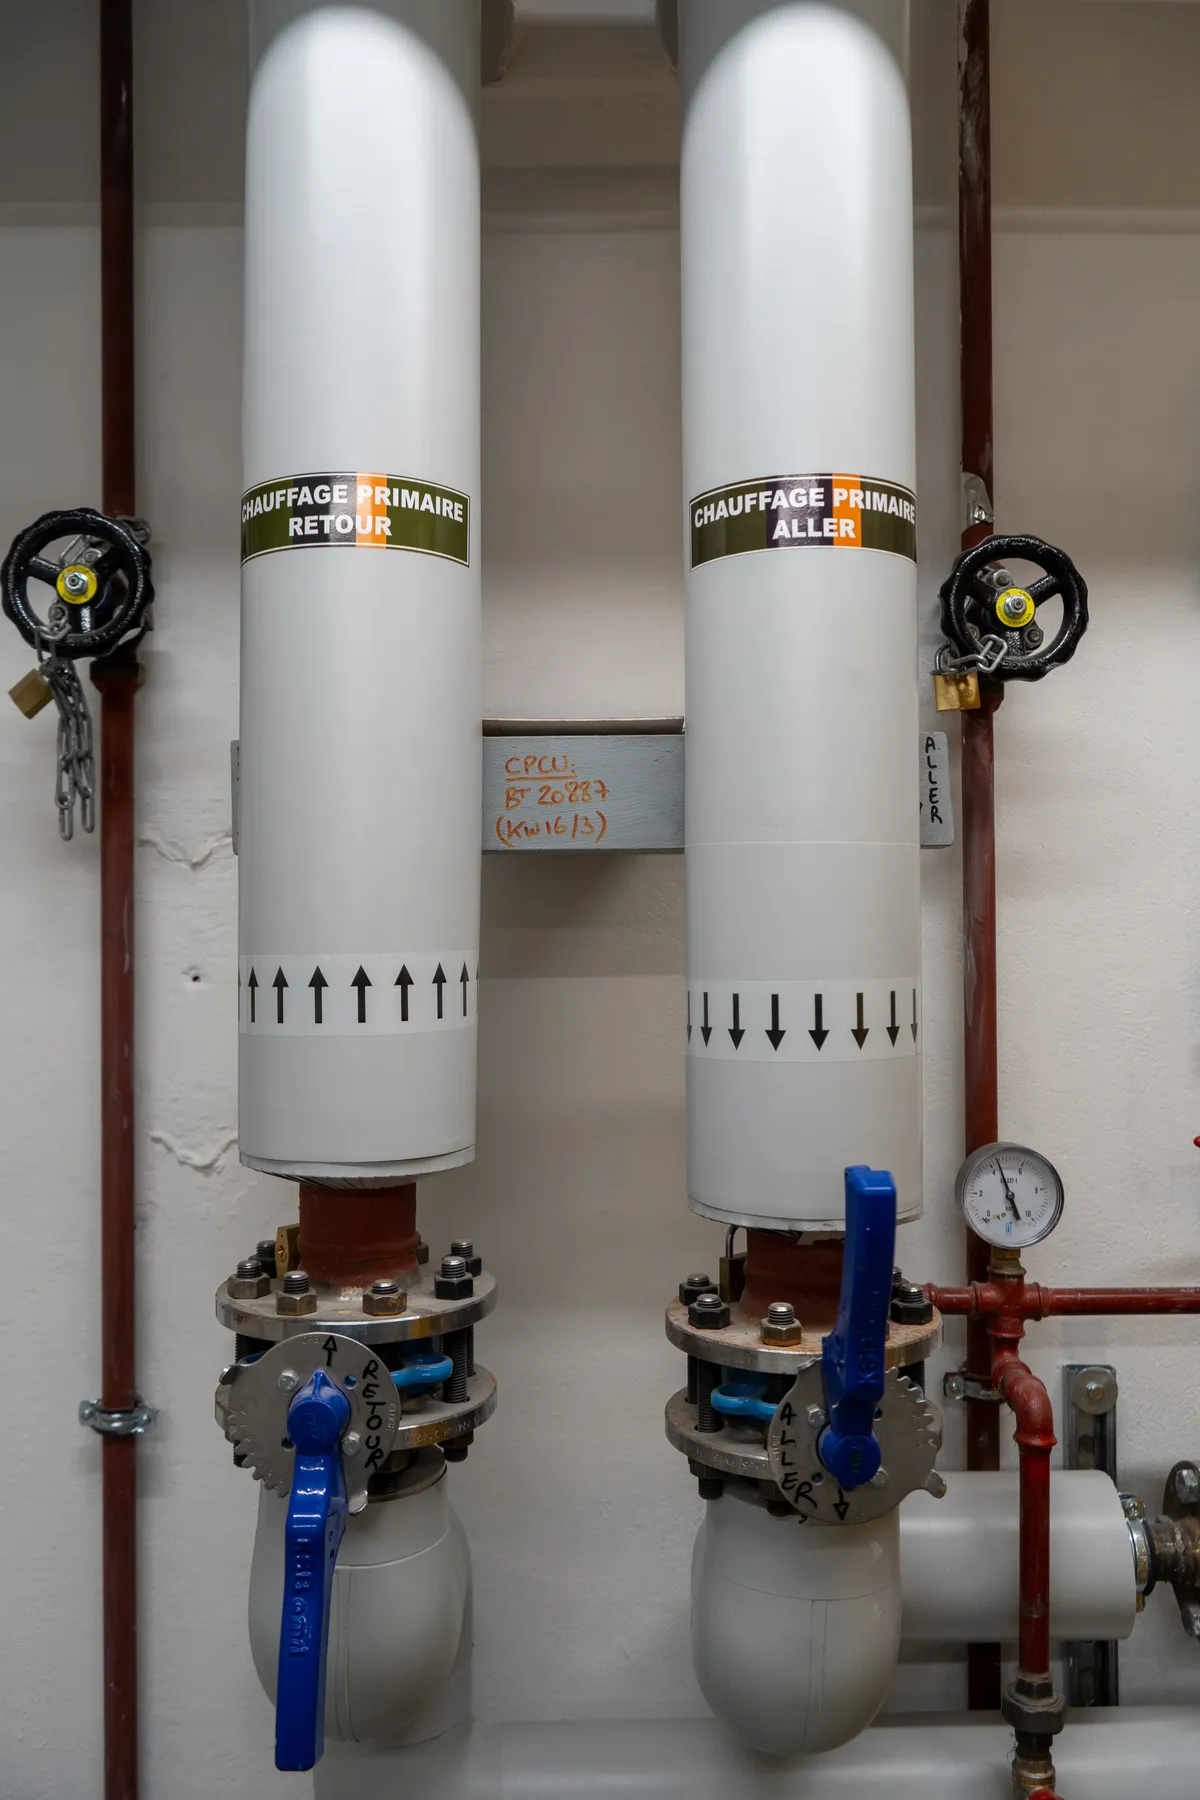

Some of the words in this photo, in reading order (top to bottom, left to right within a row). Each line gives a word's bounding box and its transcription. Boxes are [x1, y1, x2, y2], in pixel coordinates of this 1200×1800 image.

[241, 484, 348, 524] CHAUFFAGE
[356, 485, 464, 524] PRIMAIRE
[694, 487, 825, 528] CHAUFFAGE
[833, 487, 916, 525] PRIMAIRE
[288, 514, 392, 537] RETOUR
[772, 518, 856, 540] ALLER
[537, 779, 610, 806] 20887
[924, 736, 943, 825] ALLER
[361, 1359, 386, 1471] RETOUR
[779, 1402, 818, 1509] ALLER
